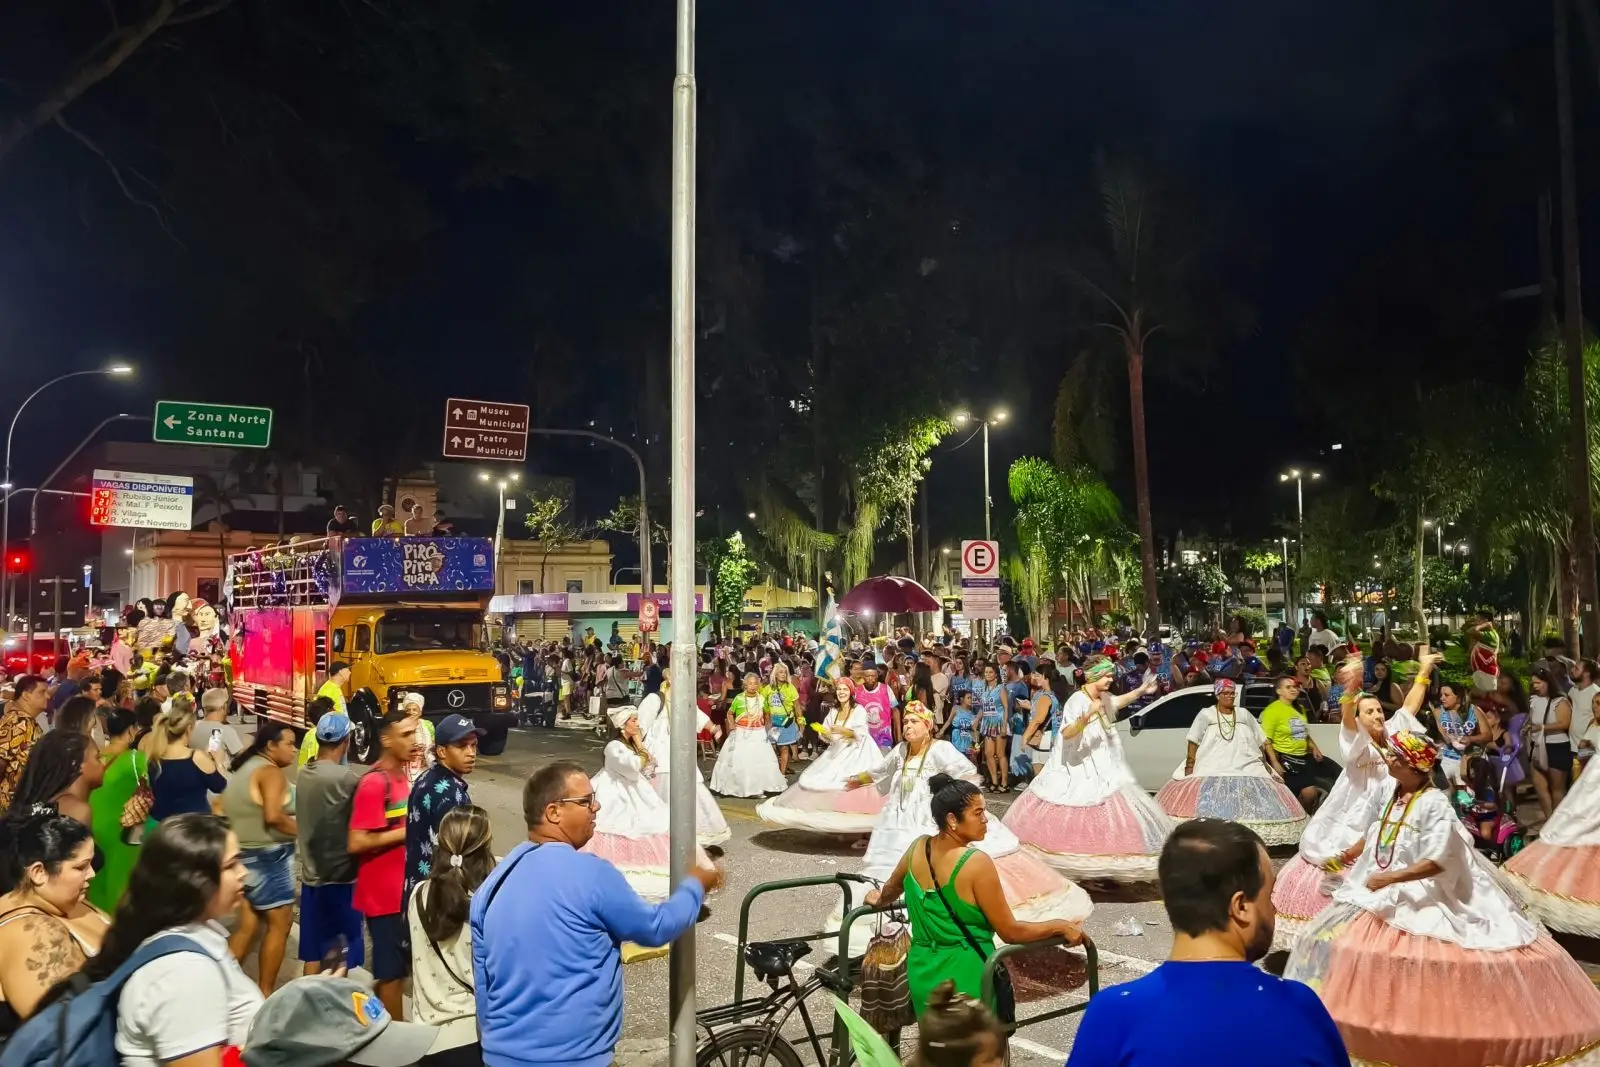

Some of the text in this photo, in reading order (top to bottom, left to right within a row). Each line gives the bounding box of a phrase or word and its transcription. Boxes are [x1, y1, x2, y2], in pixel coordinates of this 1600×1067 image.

[480, 406, 510, 416] Museu
[187, 410, 267, 425] Zona Norte
[479, 418, 525, 430] Municipal
[186, 426, 245, 439] Santana
[478, 433, 508, 443] Teatro
[476, 446, 523, 457] Municipal
[100, 480, 187, 494] VAGAS DISPONÍVEIS
[153, 502, 183, 511] Peixoto
[146, 519, 188, 529] Novembro
[974, 548, 986, 567] E
